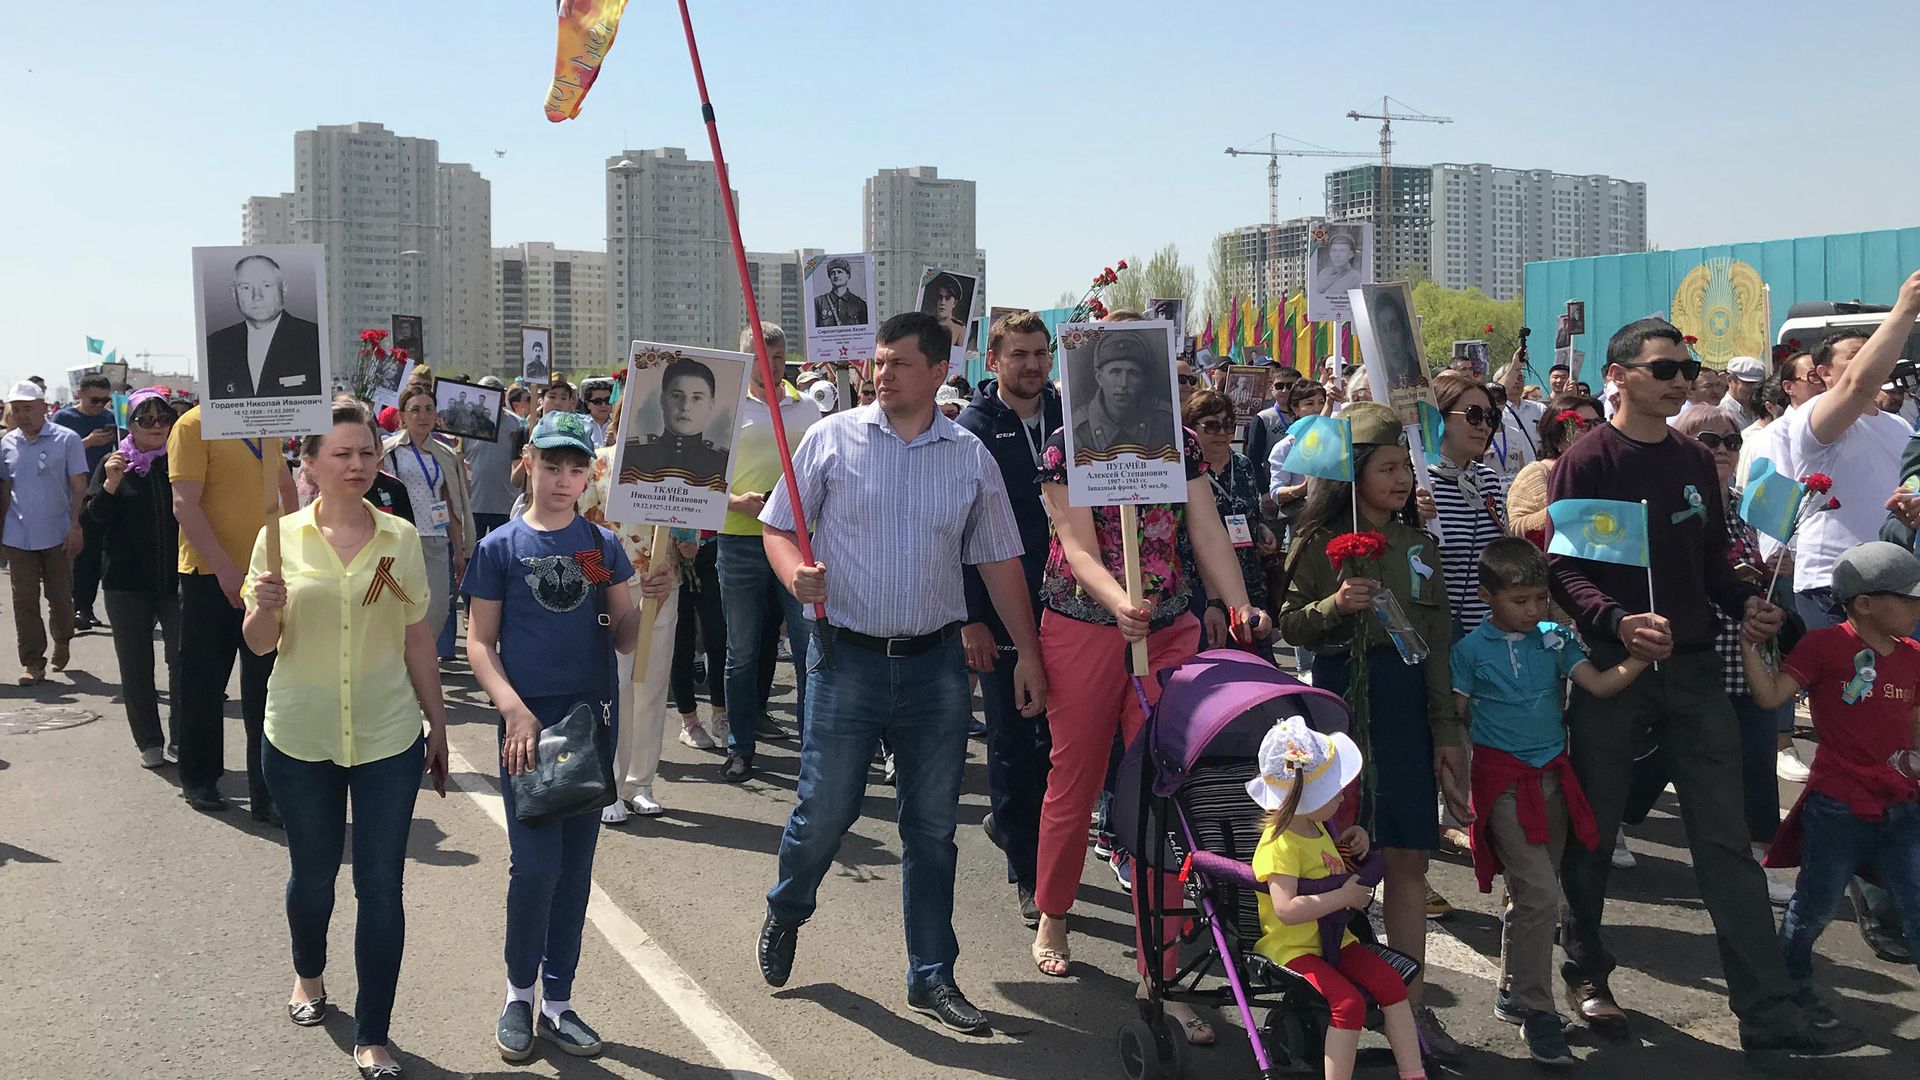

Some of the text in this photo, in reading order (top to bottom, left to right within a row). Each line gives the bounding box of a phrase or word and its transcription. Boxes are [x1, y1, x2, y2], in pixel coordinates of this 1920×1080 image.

[210, 402, 244, 410] Гордеев
[282, 398, 323, 406] Иванович
[1106, 461, 1147, 471] ПУГАЧЁВ
[1087, 470, 1168, 479] Алексей Степанович
[653, 485, 689, 496] ТКАЧЁВ
[630, 491, 708, 505] Николай Иванович
[1167, 831, 1183, 865] hello
